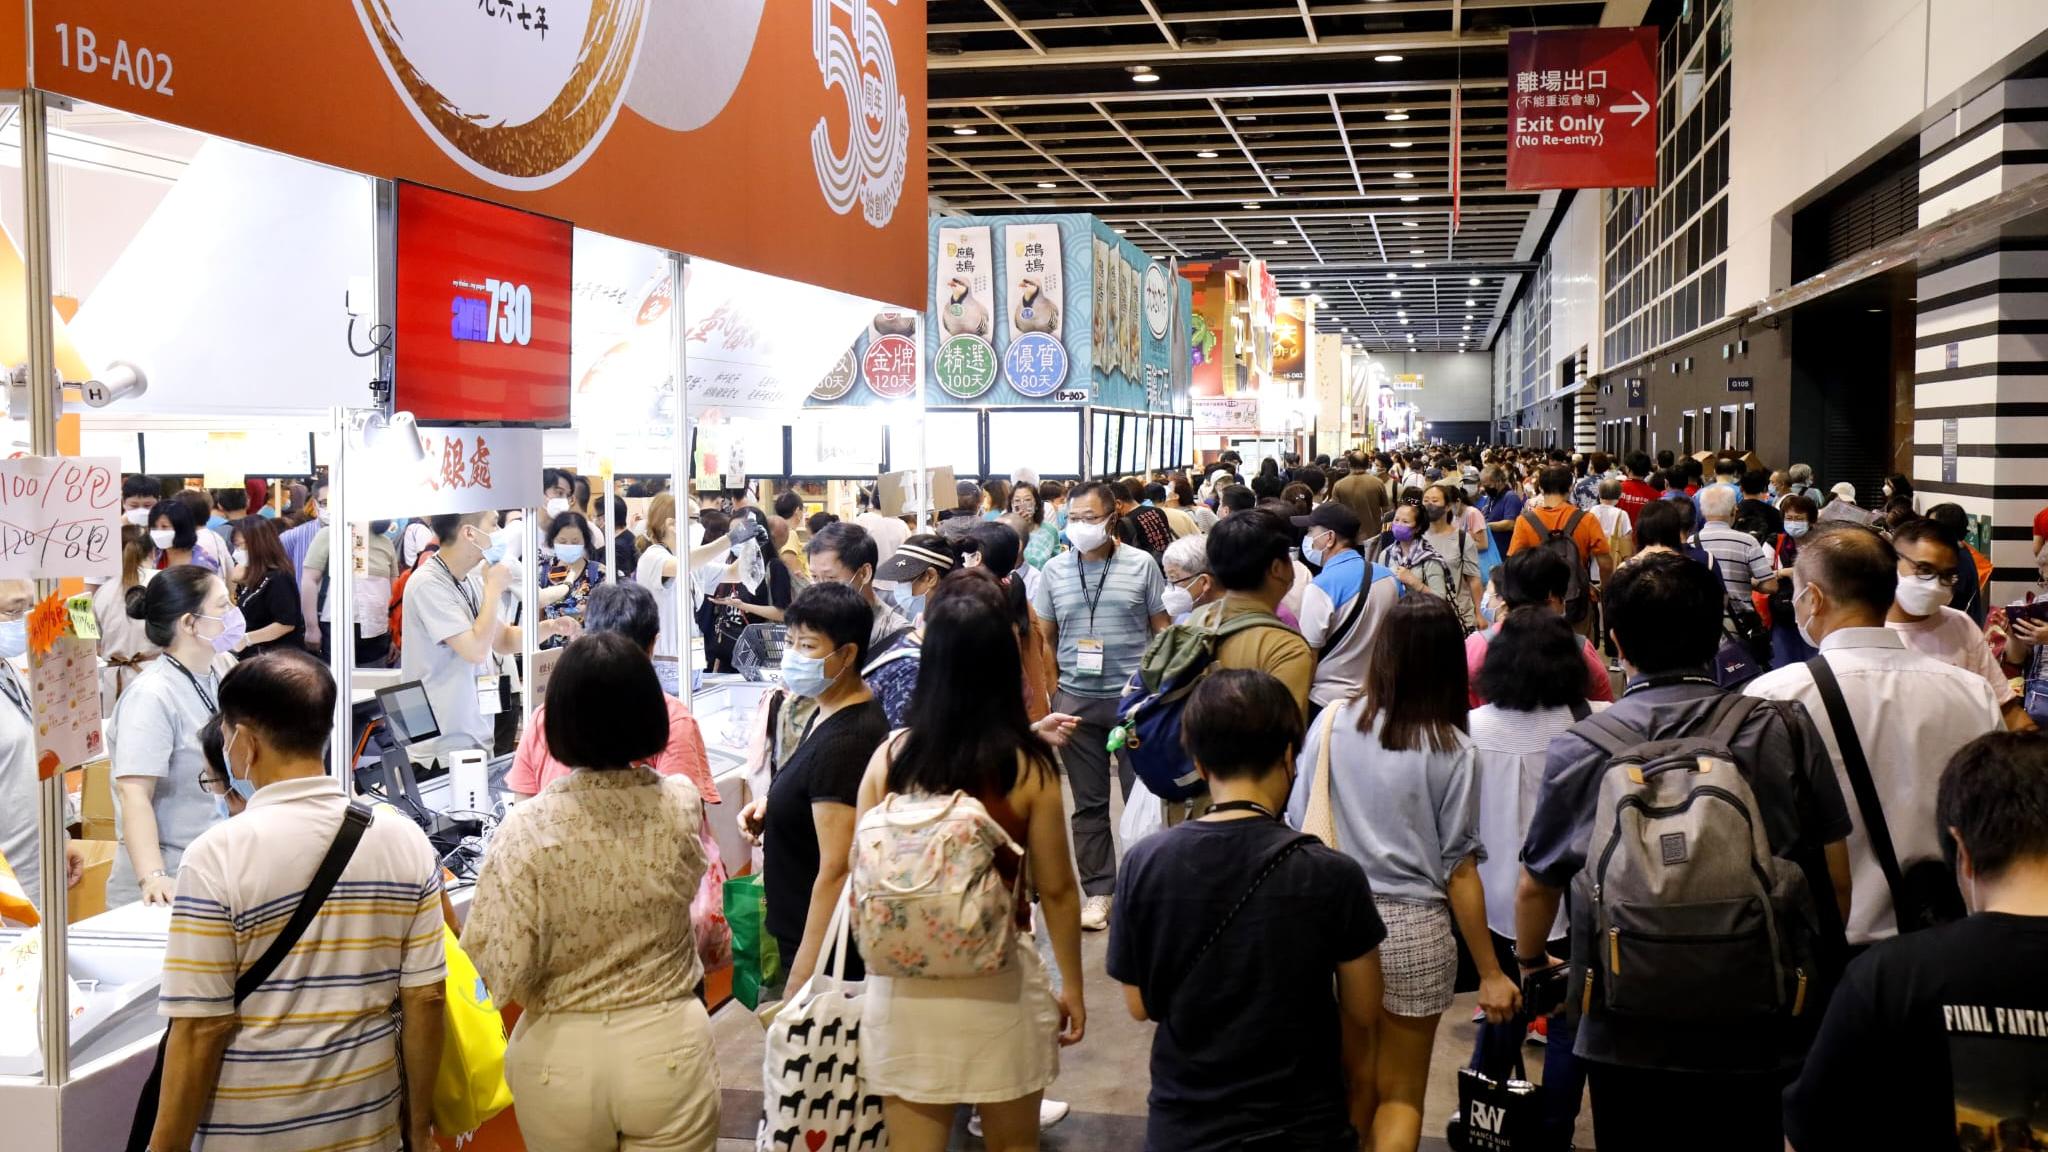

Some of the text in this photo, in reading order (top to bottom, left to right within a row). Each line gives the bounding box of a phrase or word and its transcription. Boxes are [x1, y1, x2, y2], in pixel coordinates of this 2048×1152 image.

[55, 22, 174, 97] 1B-A02
[1516, 69, 1607, 93] 離場出口
[865, 80, 883, 117] 周年
[1516, 93, 1600, 110] (不能重返會場)
[1516, 114, 1605, 134] Exit Only
[1515, 132, 1604, 149] (No Re-entry)
[451, 277, 532, 346] am730
[870, 344, 915, 373] 金牌
[943, 344, 986, 374] 精選
[1013, 344, 1057, 374] 優質
[874, 374, 912, 389] 120天
[947, 374, 984, 389] 100天
[1020, 373, 1051, 389] 80天
[1943, 1004, 1993, 1033] FINAL
